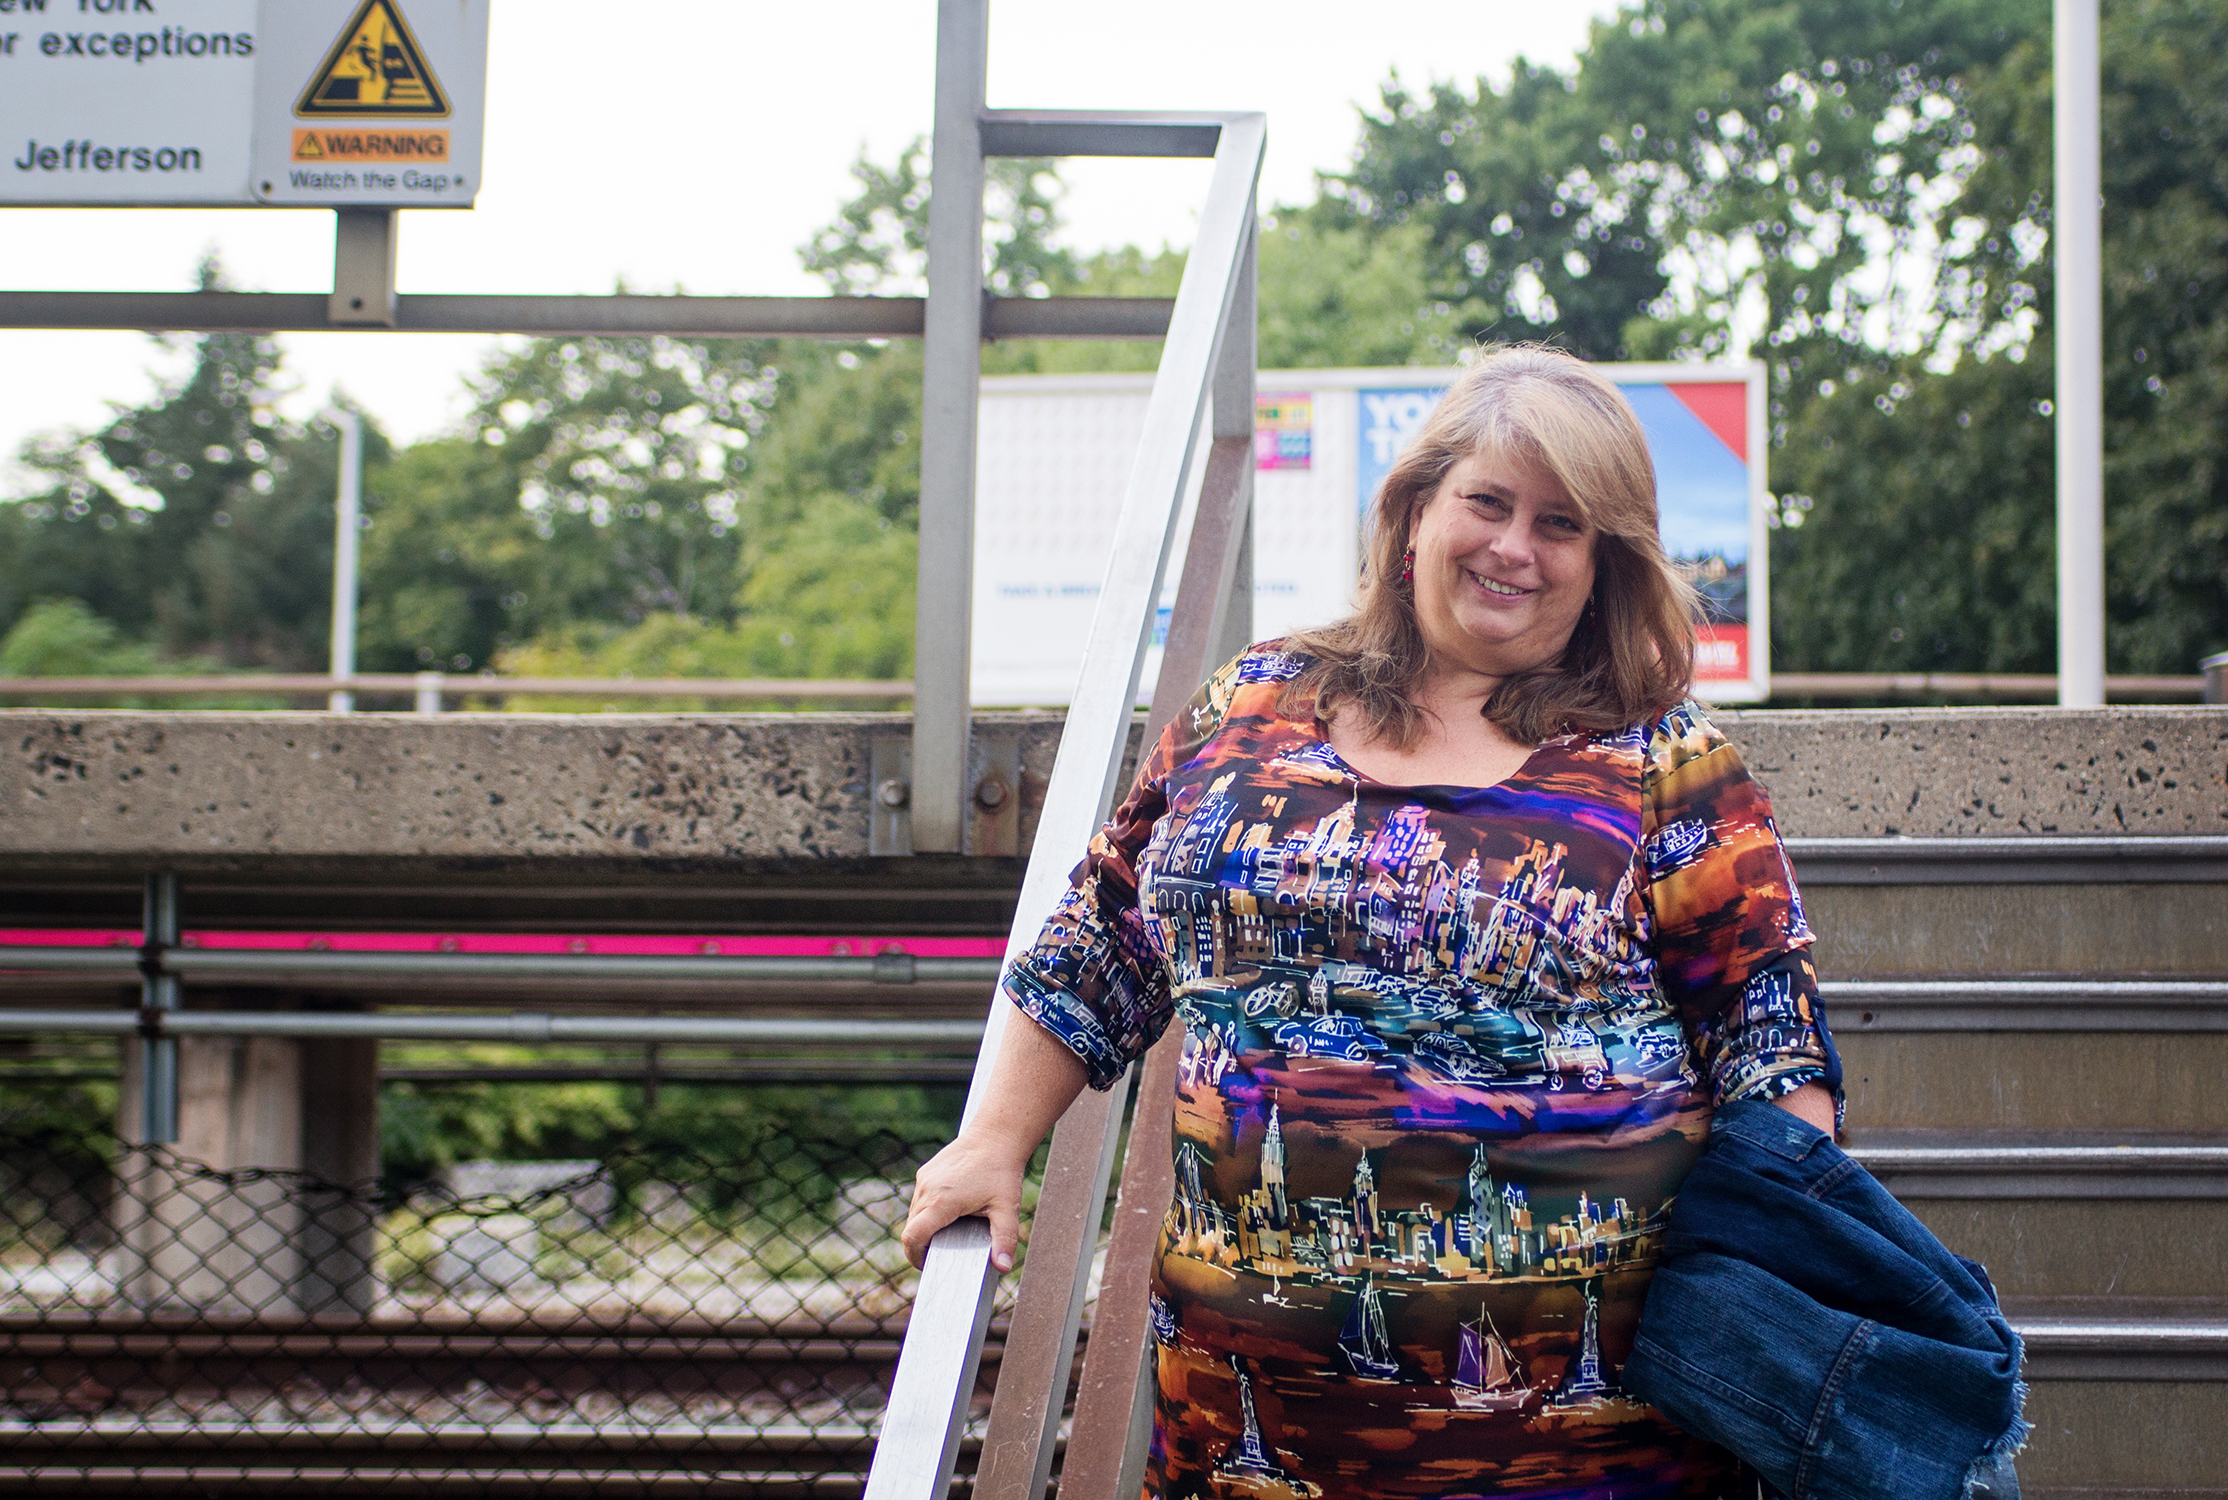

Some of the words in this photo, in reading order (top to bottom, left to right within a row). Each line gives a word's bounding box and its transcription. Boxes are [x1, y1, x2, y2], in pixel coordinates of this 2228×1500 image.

[40, 26, 253, 64] exceptions
[14, 139, 202, 171] Jefferson
[325, 134, 445, 156] WARNING
[289, 170, 357, 190] Watch
[363, 171, 397, 189] the
[402, 169, 449, 193] Gap
[1365, 393, 1442, 434] YO
